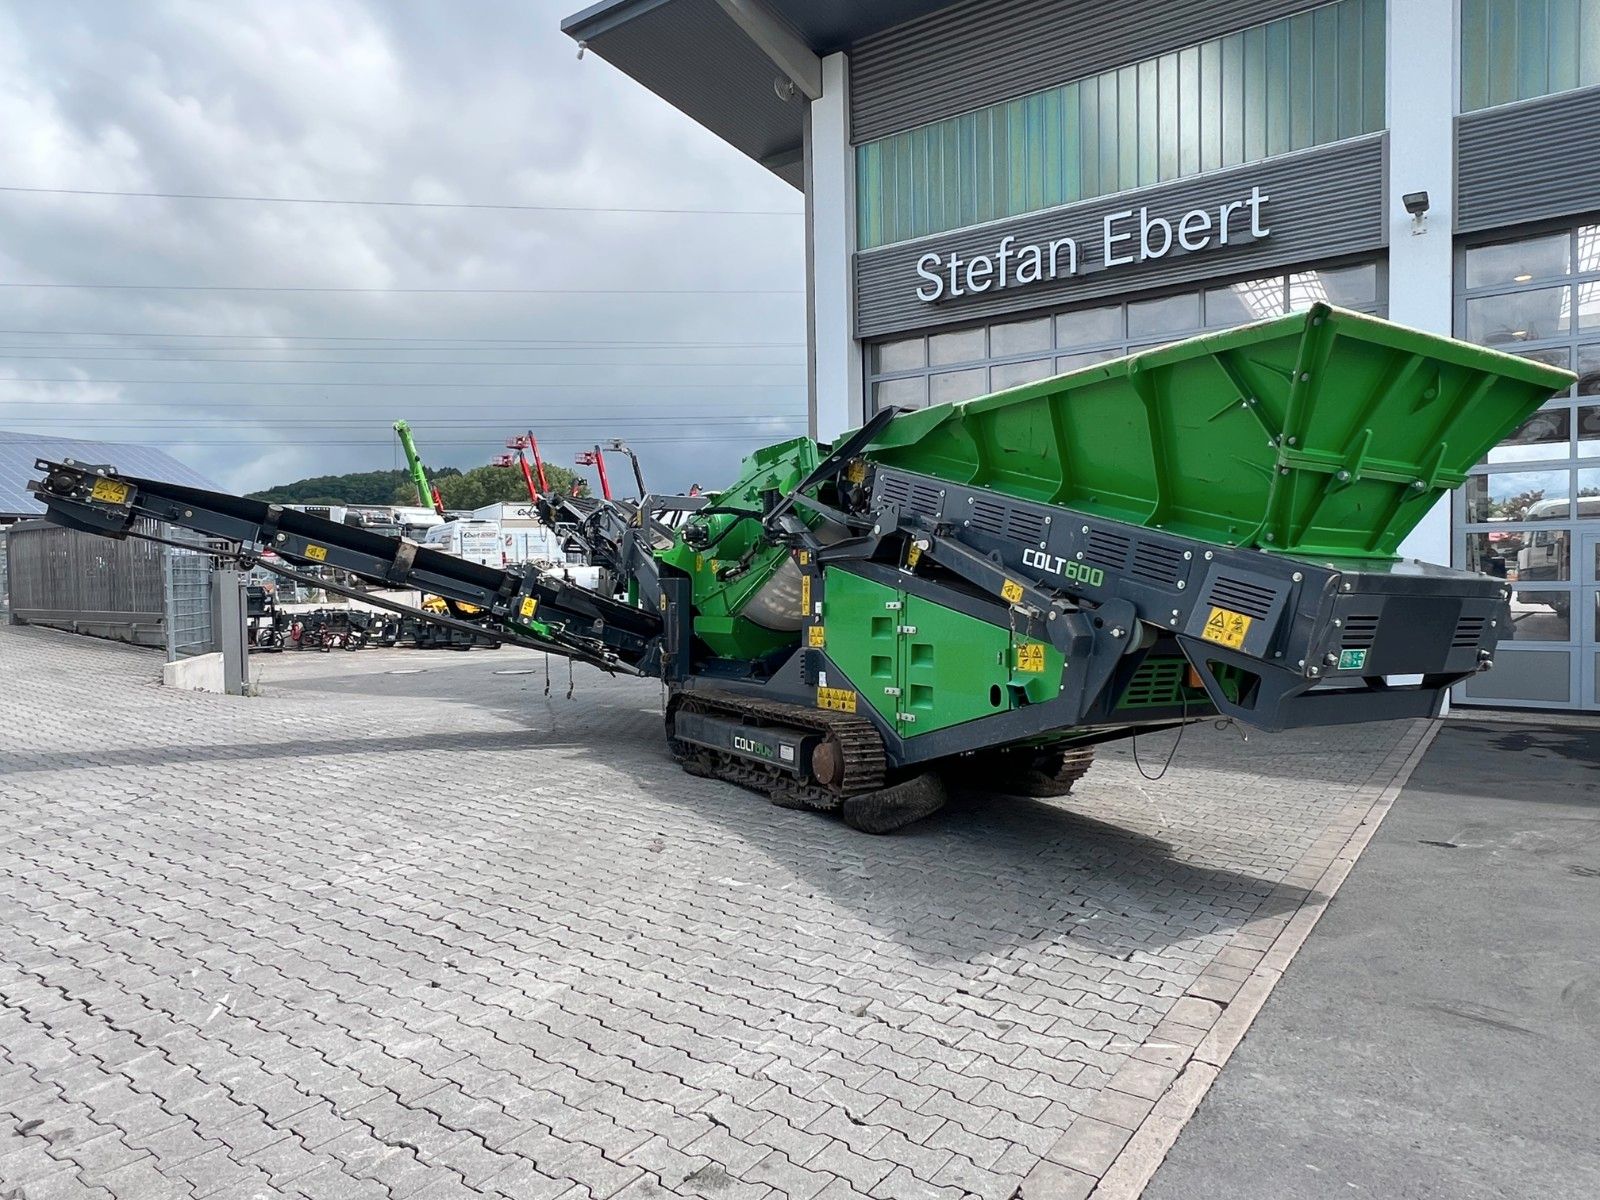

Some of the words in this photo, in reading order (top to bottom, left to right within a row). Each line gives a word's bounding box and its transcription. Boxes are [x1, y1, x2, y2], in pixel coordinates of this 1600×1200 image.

[916, 236, 1077, 302] Stefan
[1103, 186, 1270, 267] Ebert
[1022, 548, 1104, 587] COLT600
